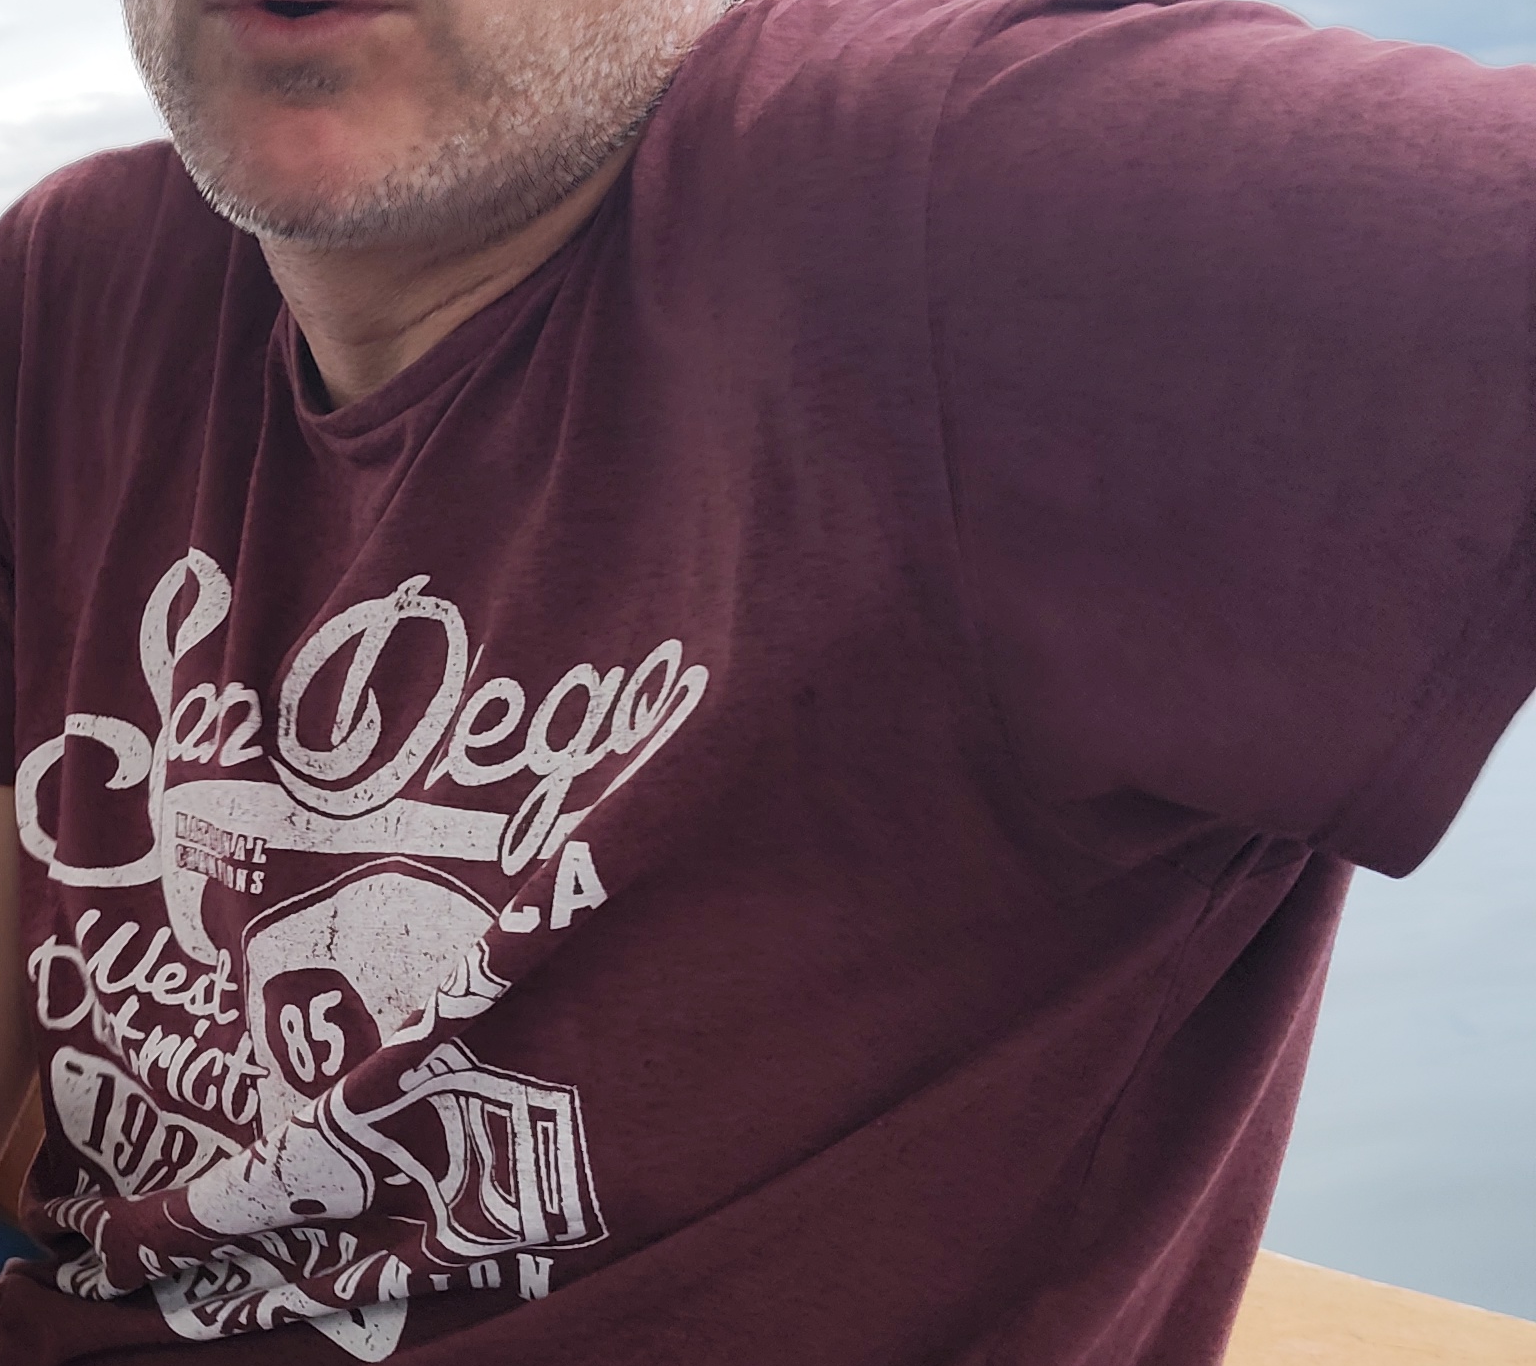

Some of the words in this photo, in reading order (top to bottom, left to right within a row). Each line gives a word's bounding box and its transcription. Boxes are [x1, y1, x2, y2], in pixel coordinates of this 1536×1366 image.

[14, 546, 264, 888] San
[267, 574, 710, 876] Dego
[75, 908, 240, 1025] West
[279, 989, 345, 1083] 85
[80, 1071, 238, 1197] 198
